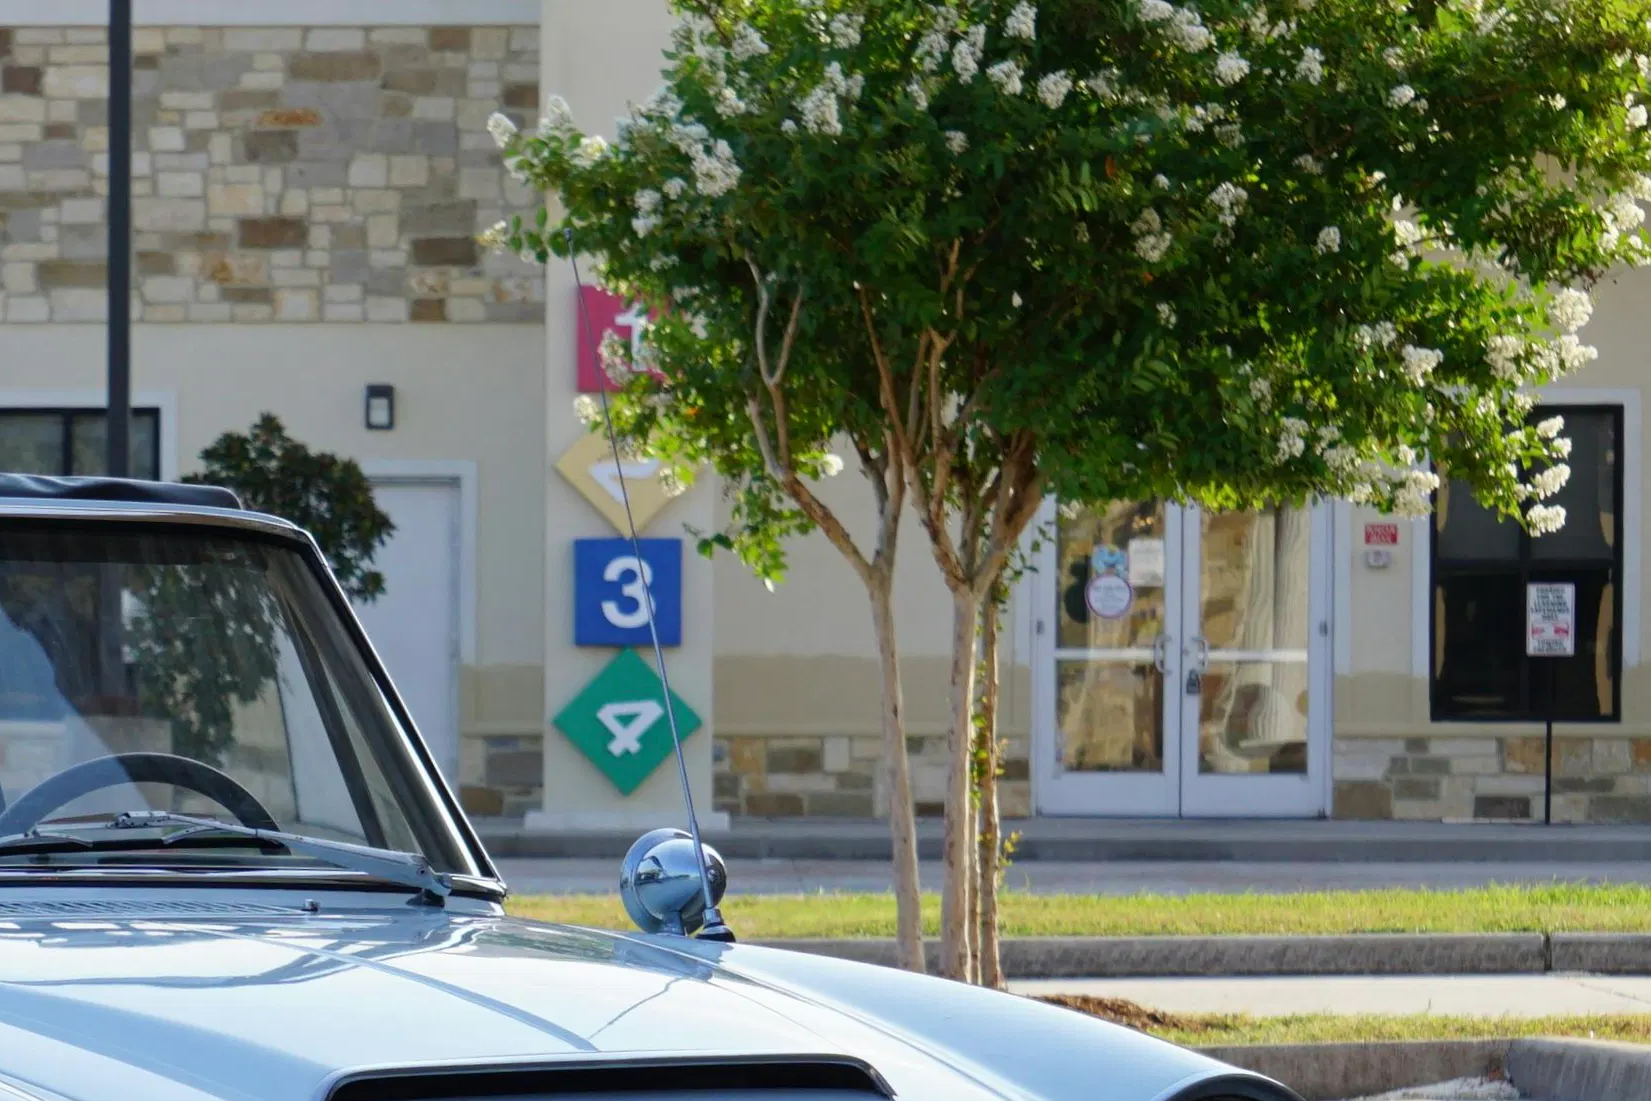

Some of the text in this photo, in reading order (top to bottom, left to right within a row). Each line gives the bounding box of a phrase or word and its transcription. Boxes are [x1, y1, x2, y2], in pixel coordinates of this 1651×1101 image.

[614, 301, 647, 371] 1
[601, 556, 656, 628] 3
[596, 700, 665, 758] 4
